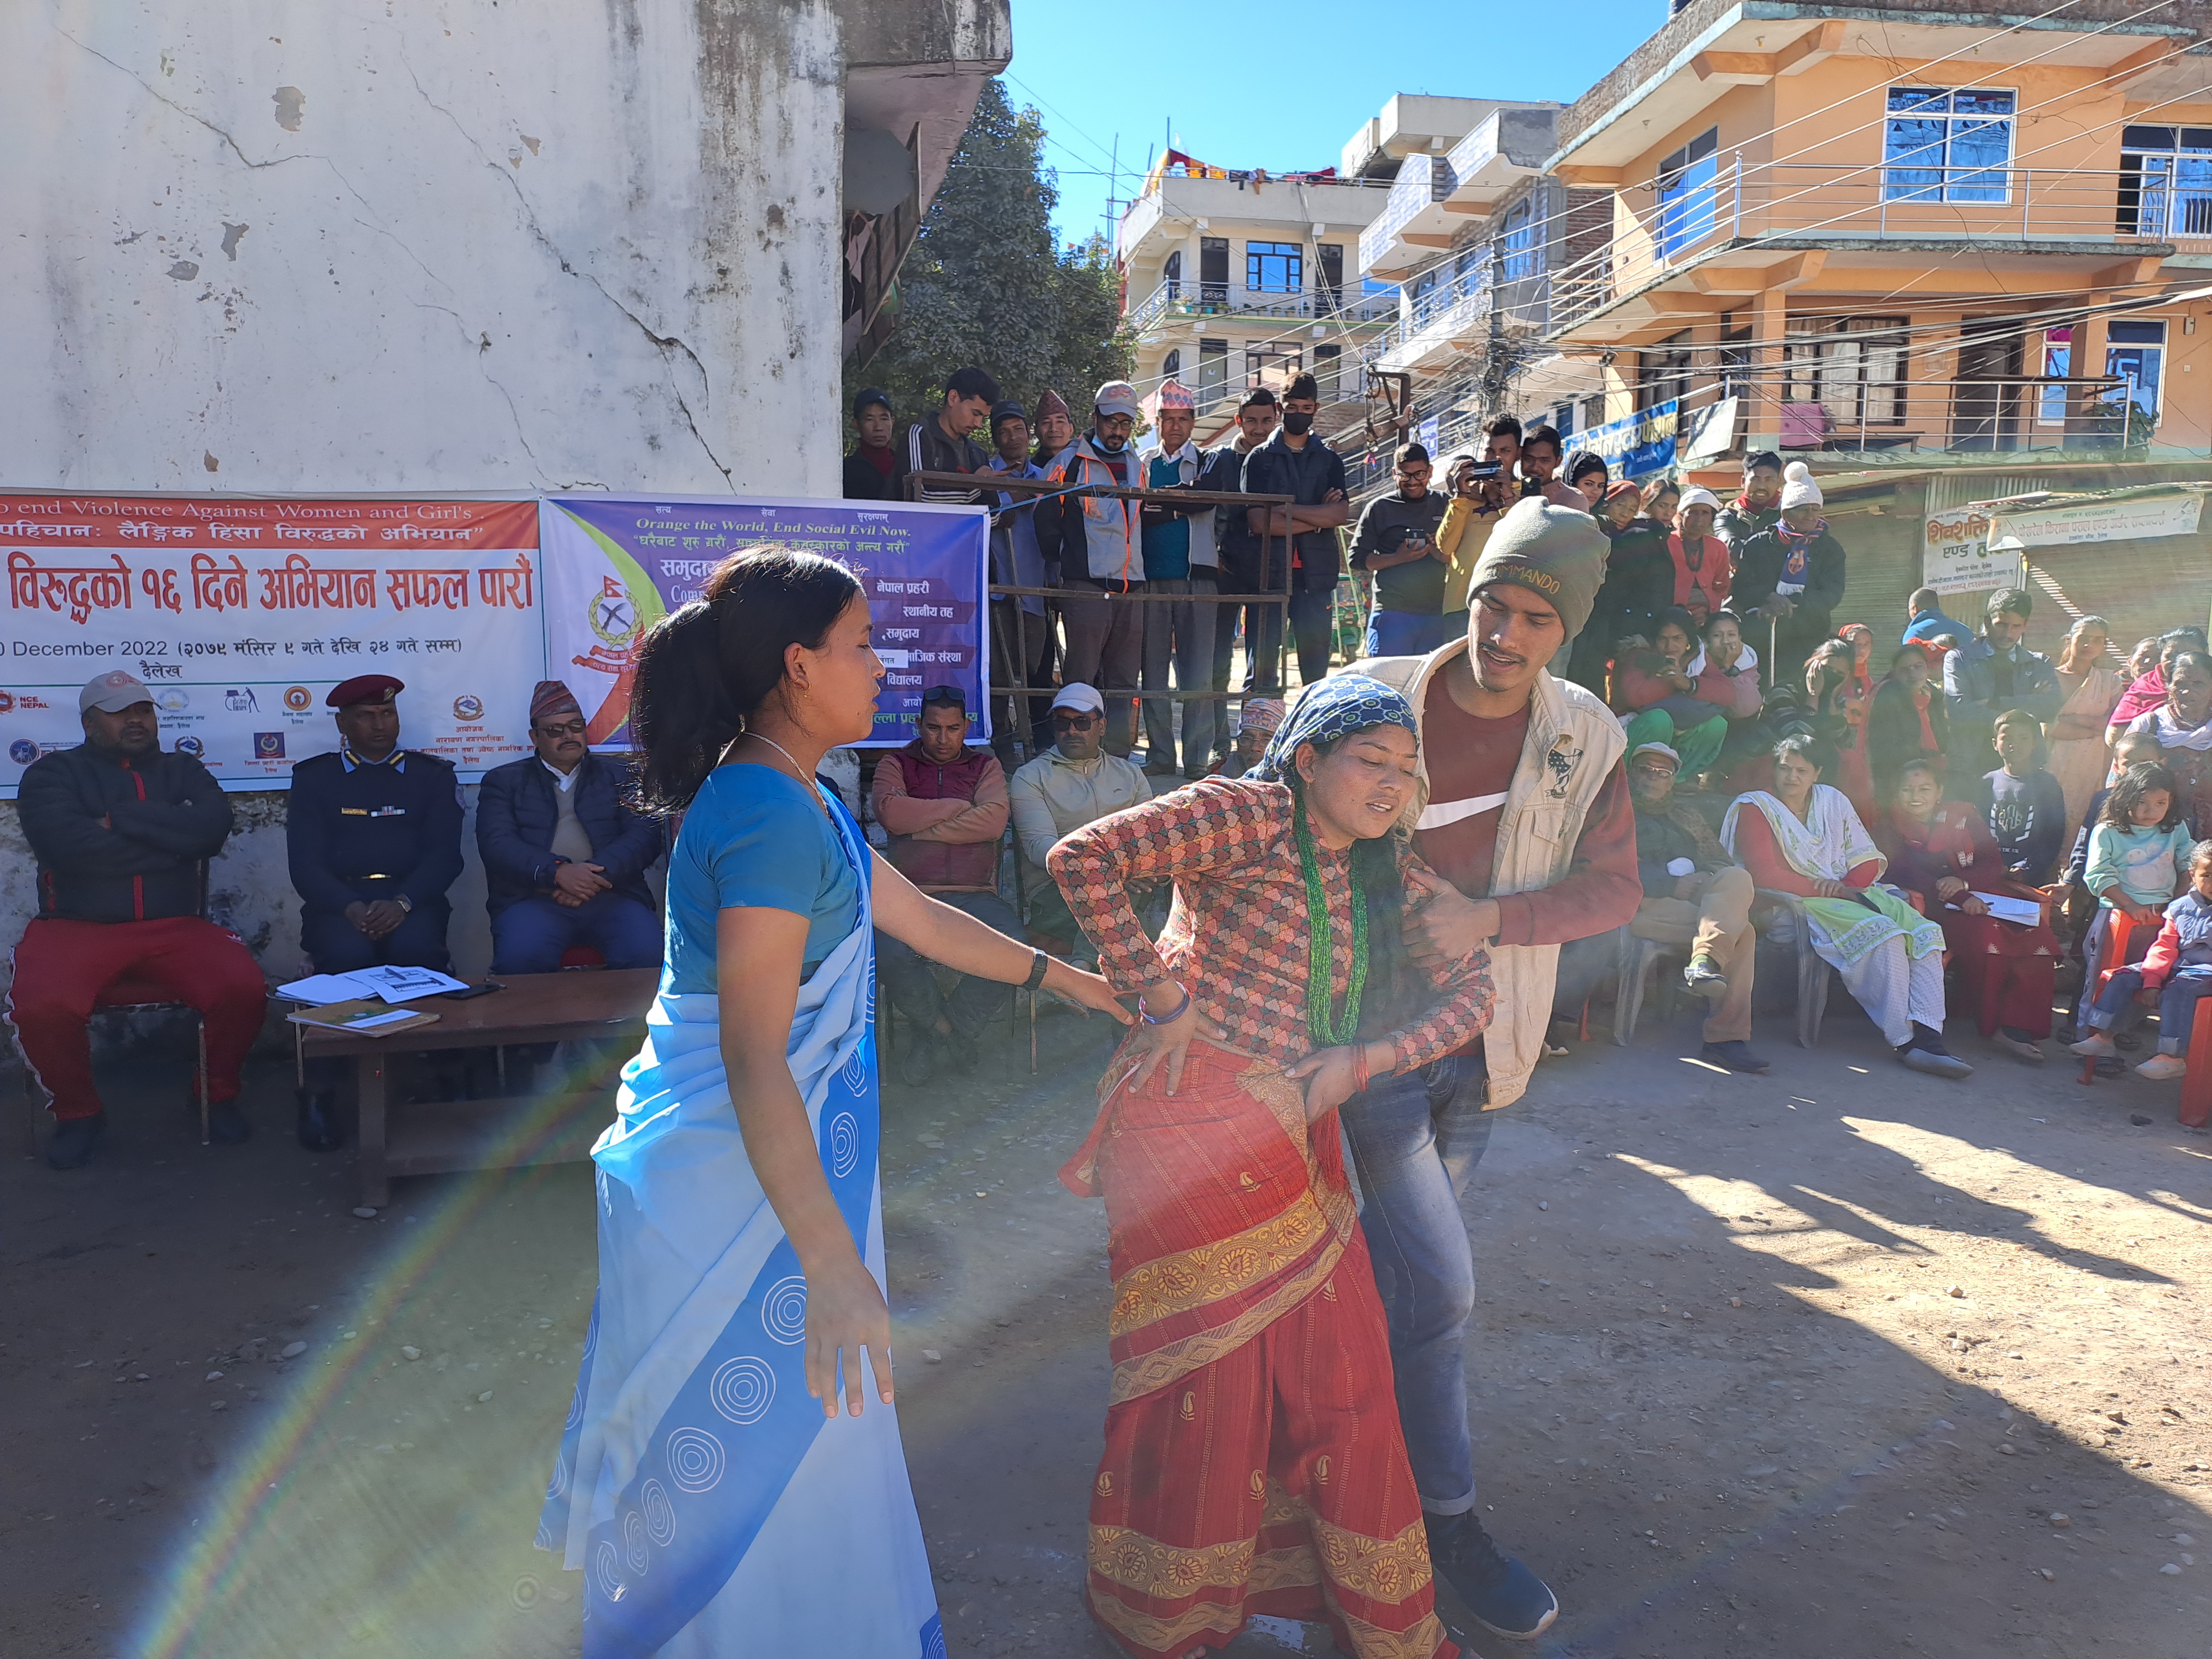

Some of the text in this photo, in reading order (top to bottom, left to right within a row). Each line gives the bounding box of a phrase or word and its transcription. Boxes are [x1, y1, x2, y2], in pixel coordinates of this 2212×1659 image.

[18, 501, 60, 514] end
[71, 500, 173, 517] Violence
[182, 502, 266, 521] Against
[276, 504, 361, 518] Women
[369, 505, 408, 519] and
[655, 505, 672, 514] सत्य
[760, 508, 776, 517] सेवा
[207, 522, 263, 541] हिंसा
[637, 518, 911, 537] Orange the World, End Social Evil Now.
[855, 541, 881, 552] अन्त्य
[1943, 544, 1970, 559] एण्ड
[142, 568, 181, 614] १६
[191, 553, 248, 613] दिने
[257, 554, 377, 611] अभियान
[385, 569, 469, 612] सफल
[877, 580, 930, 594] नेपाल प्रहरी
[902, 604, 954, 618] स्थानीय तह
[886, 628, 920, 641] समुदाय
[13, 641, 114, 656] December
[121, 641, 168, 656] 2022
[234, 639, 276, 657] मंसिर
[301, 639, 325, 656] गते
[331, 638, 361, 656] देखि
[369, 640, 389, 656] २४
[397, 638, 419, 655] गते
[938, 650, 962, 663] संस्था
[139, 660, 183, 680] दैलेख
[887, 672, 922, 686] विद्यालय
